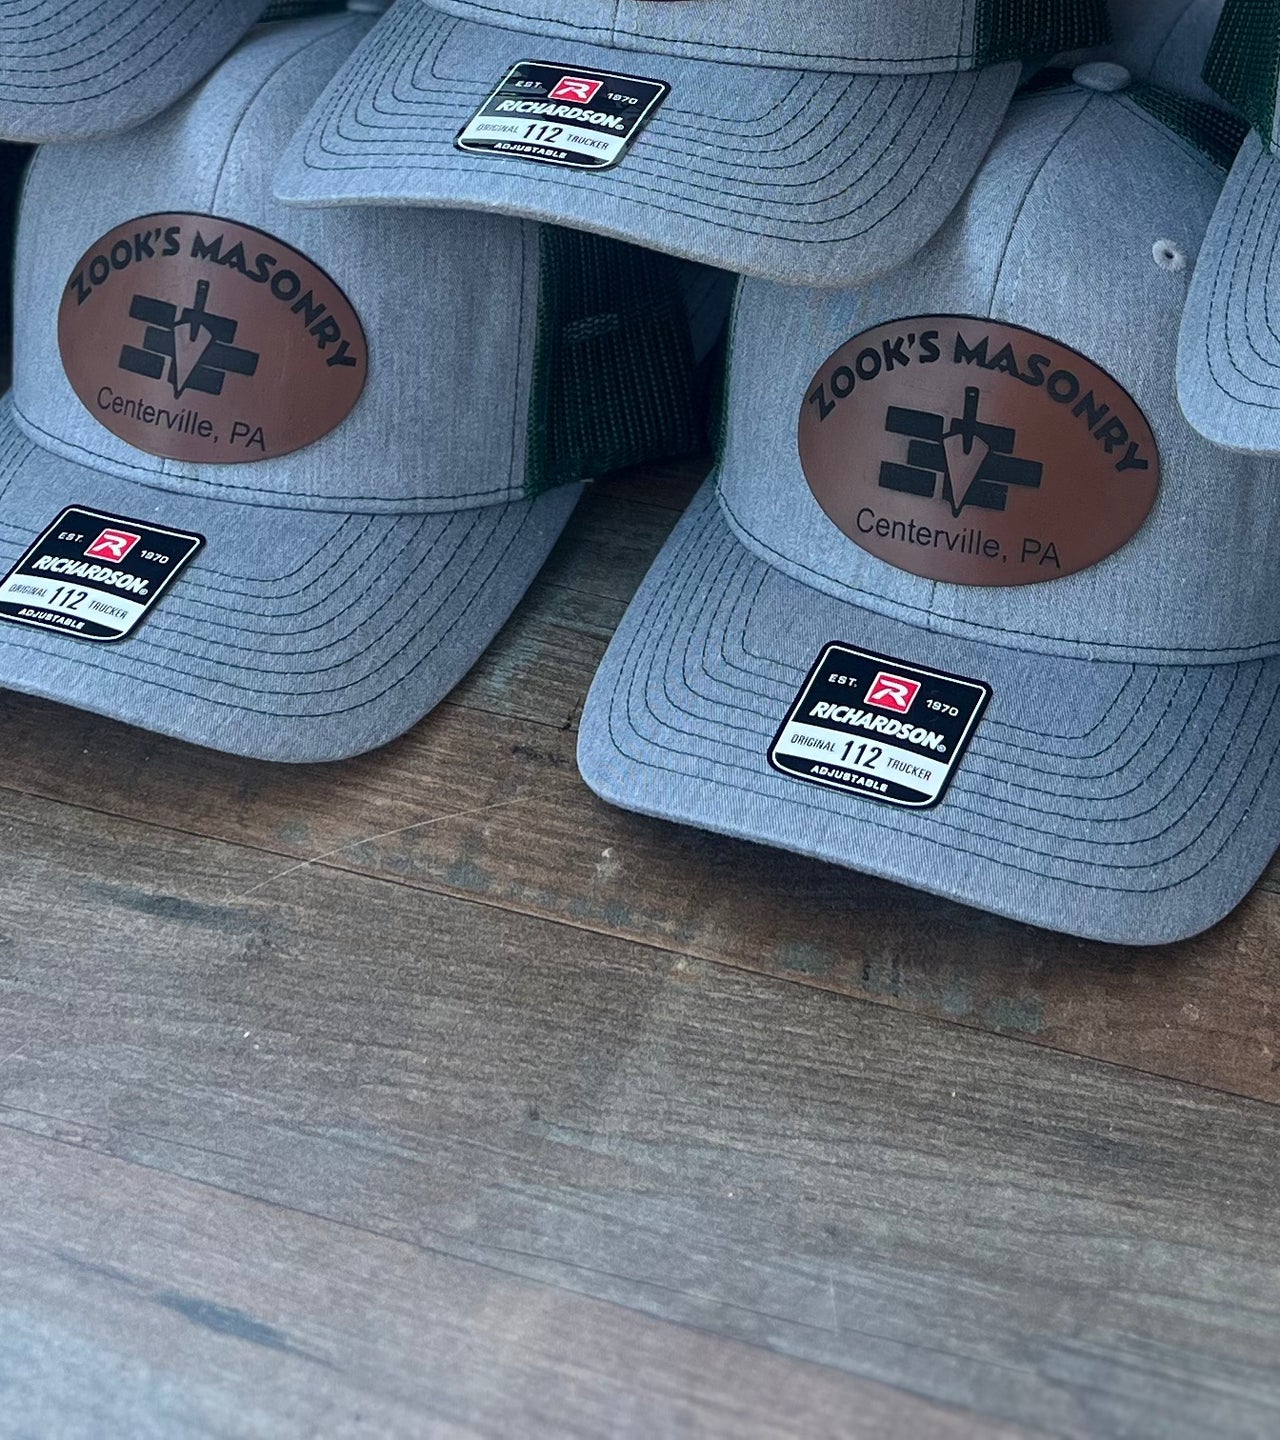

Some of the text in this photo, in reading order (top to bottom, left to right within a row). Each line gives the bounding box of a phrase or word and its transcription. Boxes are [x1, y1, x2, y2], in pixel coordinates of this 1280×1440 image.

[523, 124, 563, 143] 112
[567, 134, 610, 150] TRUCKER
[71, 226, 357, 368] ZOOK'S MASONRY
[97, 386, 266, 452] Centerville, PA
[809, 331, 1149, 473] ZOOK'S MASONRY
[856, 508, 1061, 569] Centerville, PA
[48, 586, 88, 611] 112
[89, 600, 128, 620] TRUCKER
[828, 673, 959, 717] EST. 1970
[791, 733, 933, 781] ORIGINAL 112 TRUCKER
[811, 765, 888, 793] ADJUSTABLE
